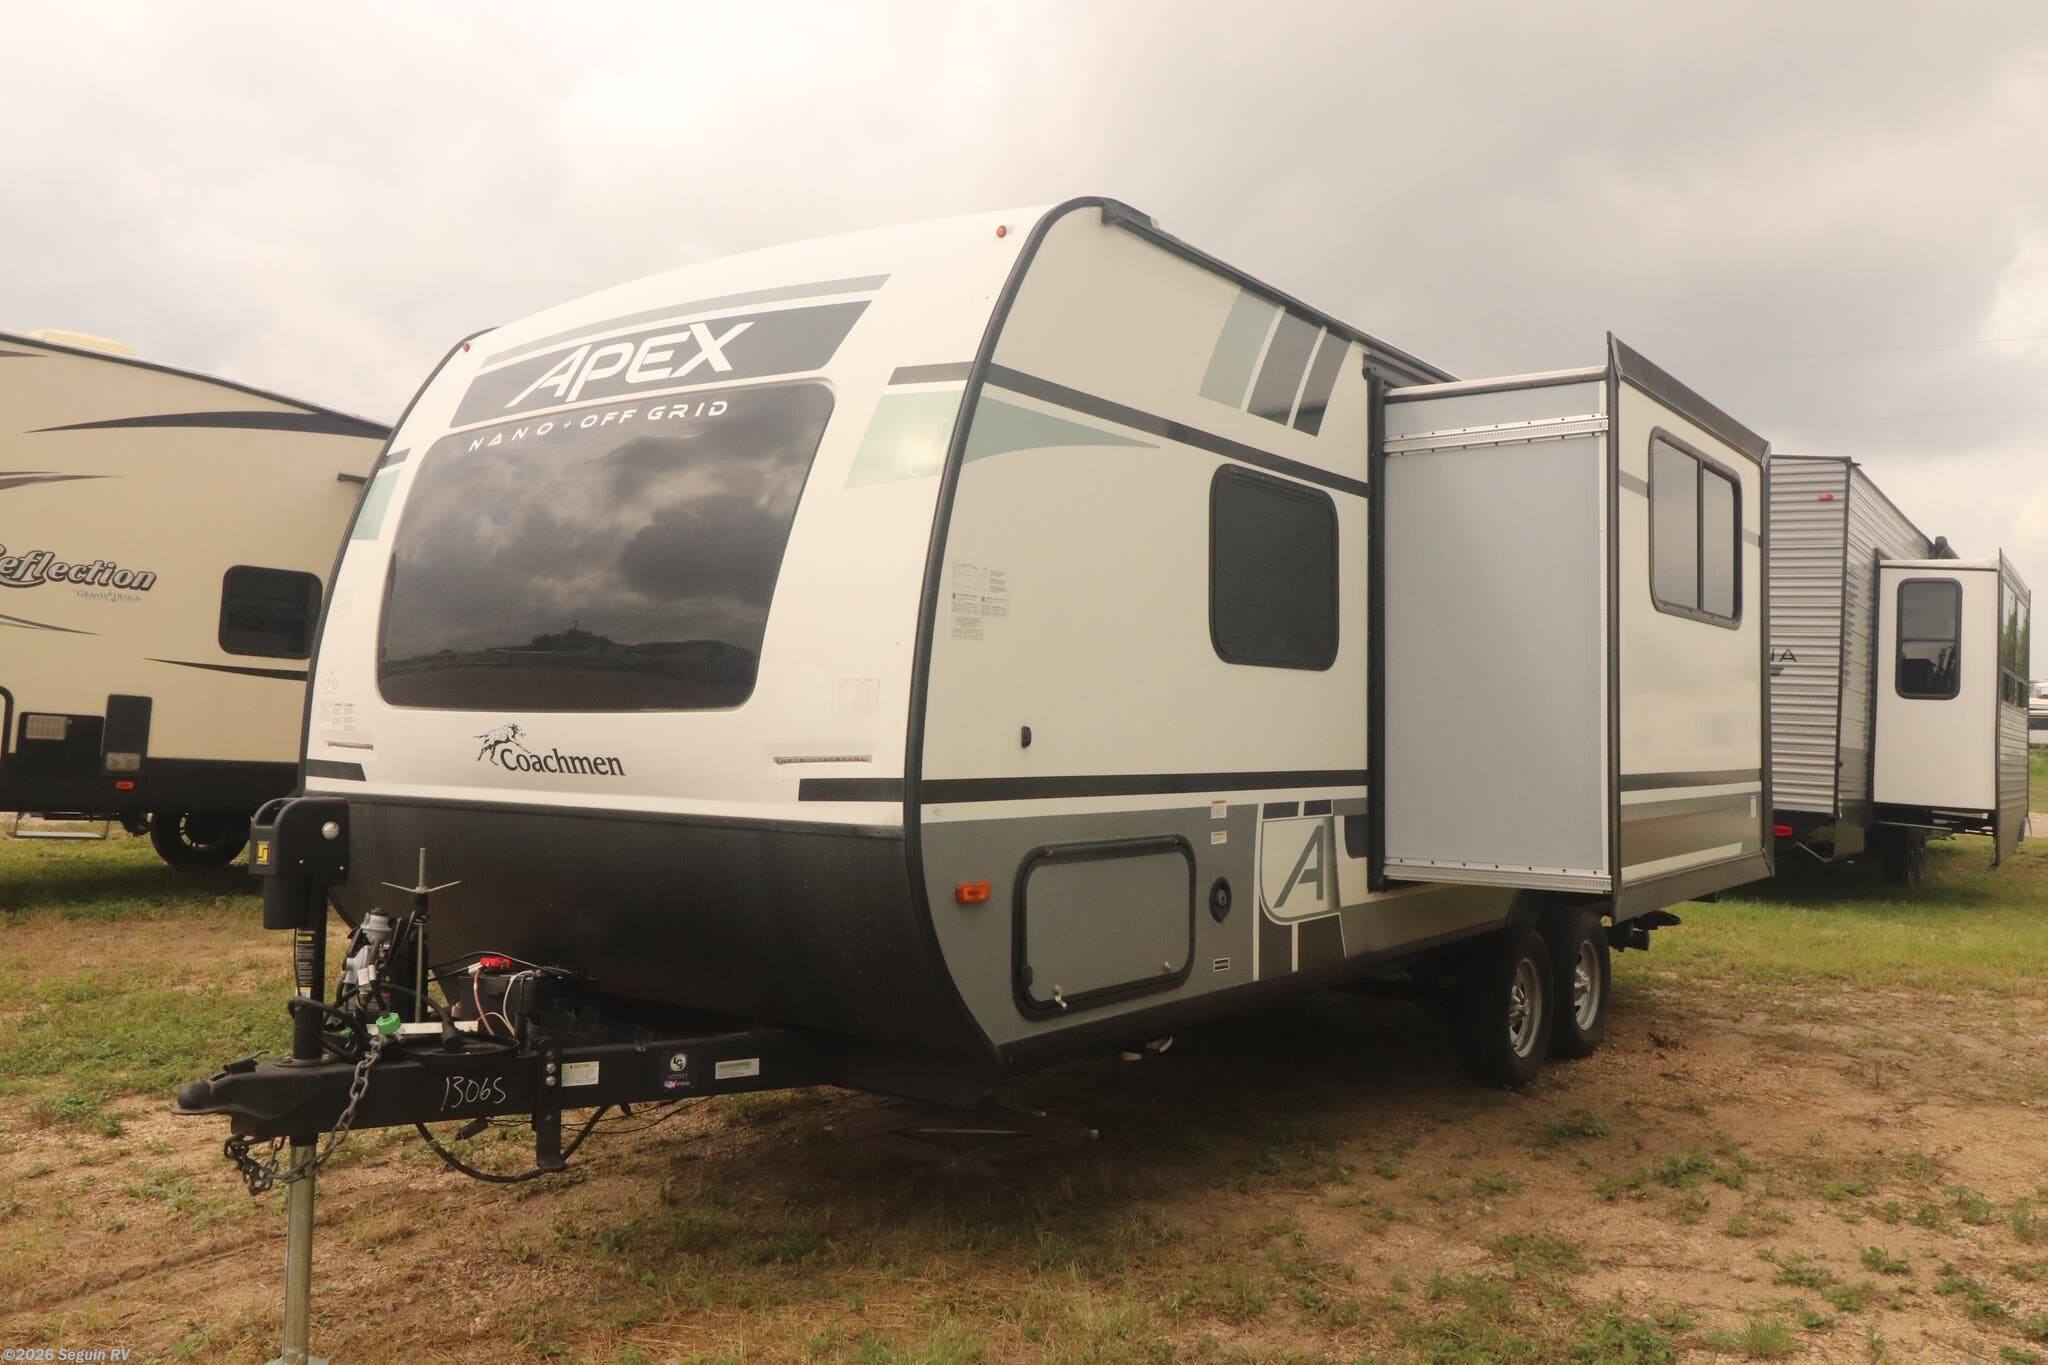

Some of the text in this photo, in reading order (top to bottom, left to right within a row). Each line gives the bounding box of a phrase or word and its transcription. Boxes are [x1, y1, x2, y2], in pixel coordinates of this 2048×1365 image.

[504, 321, 756, 409] APEX
[468, 400, 729, 452] NANO OFF GRID
[0, 544, 157, 591] eflection
[500, 748, 626, 776] Coachmen
[1273, 825, 1324, 908] A
